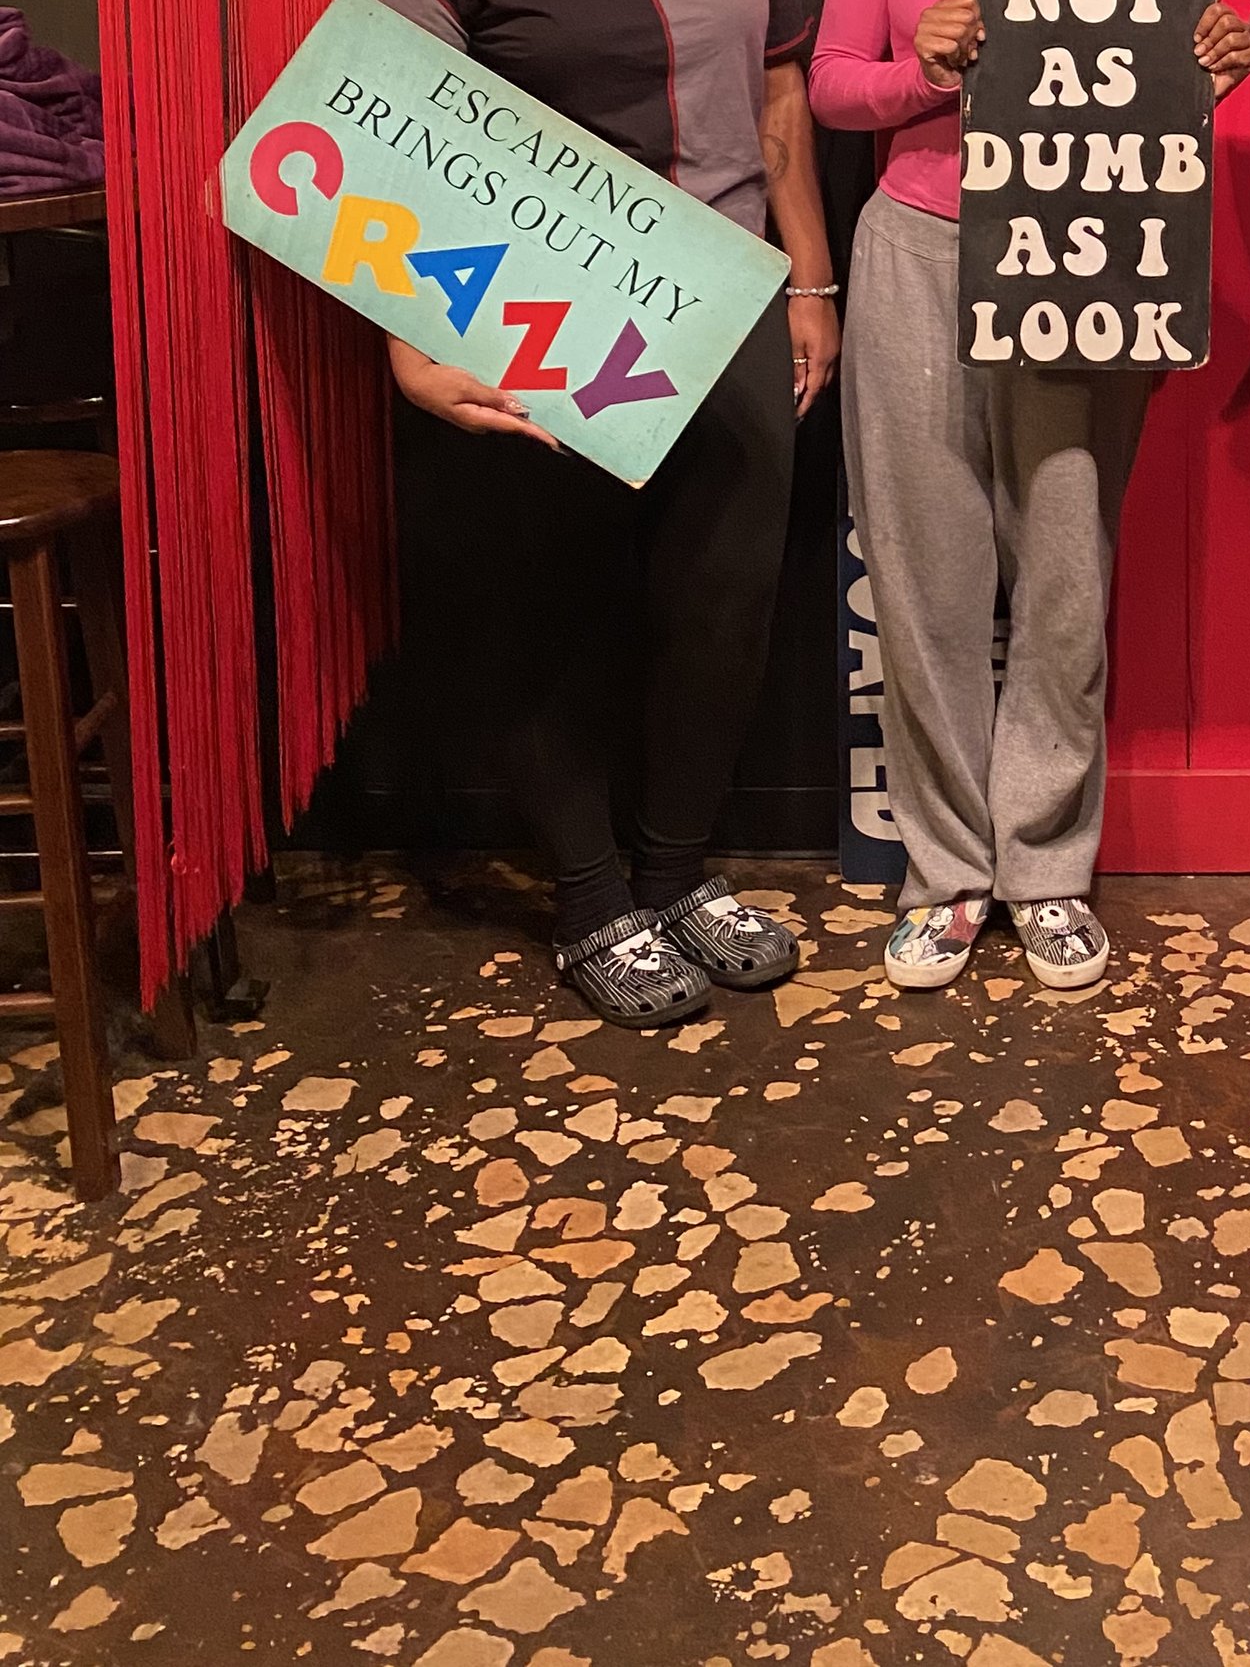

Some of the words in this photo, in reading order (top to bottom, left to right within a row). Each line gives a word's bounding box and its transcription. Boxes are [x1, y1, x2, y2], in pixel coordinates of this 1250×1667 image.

[1028, 47, 1137, 108] AS
[426, 70, 666, 235] ESCAPING
[960, 131, 1206, 193] DUMB
[325, 76, 507, 207] BRINGS
[511, 195, 616, 272] OUT
[612, 257, 702, 324] MY
[250, 121, 680, 420] CRAZY
[996, 216, 1108, 277] AS
[1136, 218, 1169, 277] I
[969, 300, 1193, 362] LOOK
